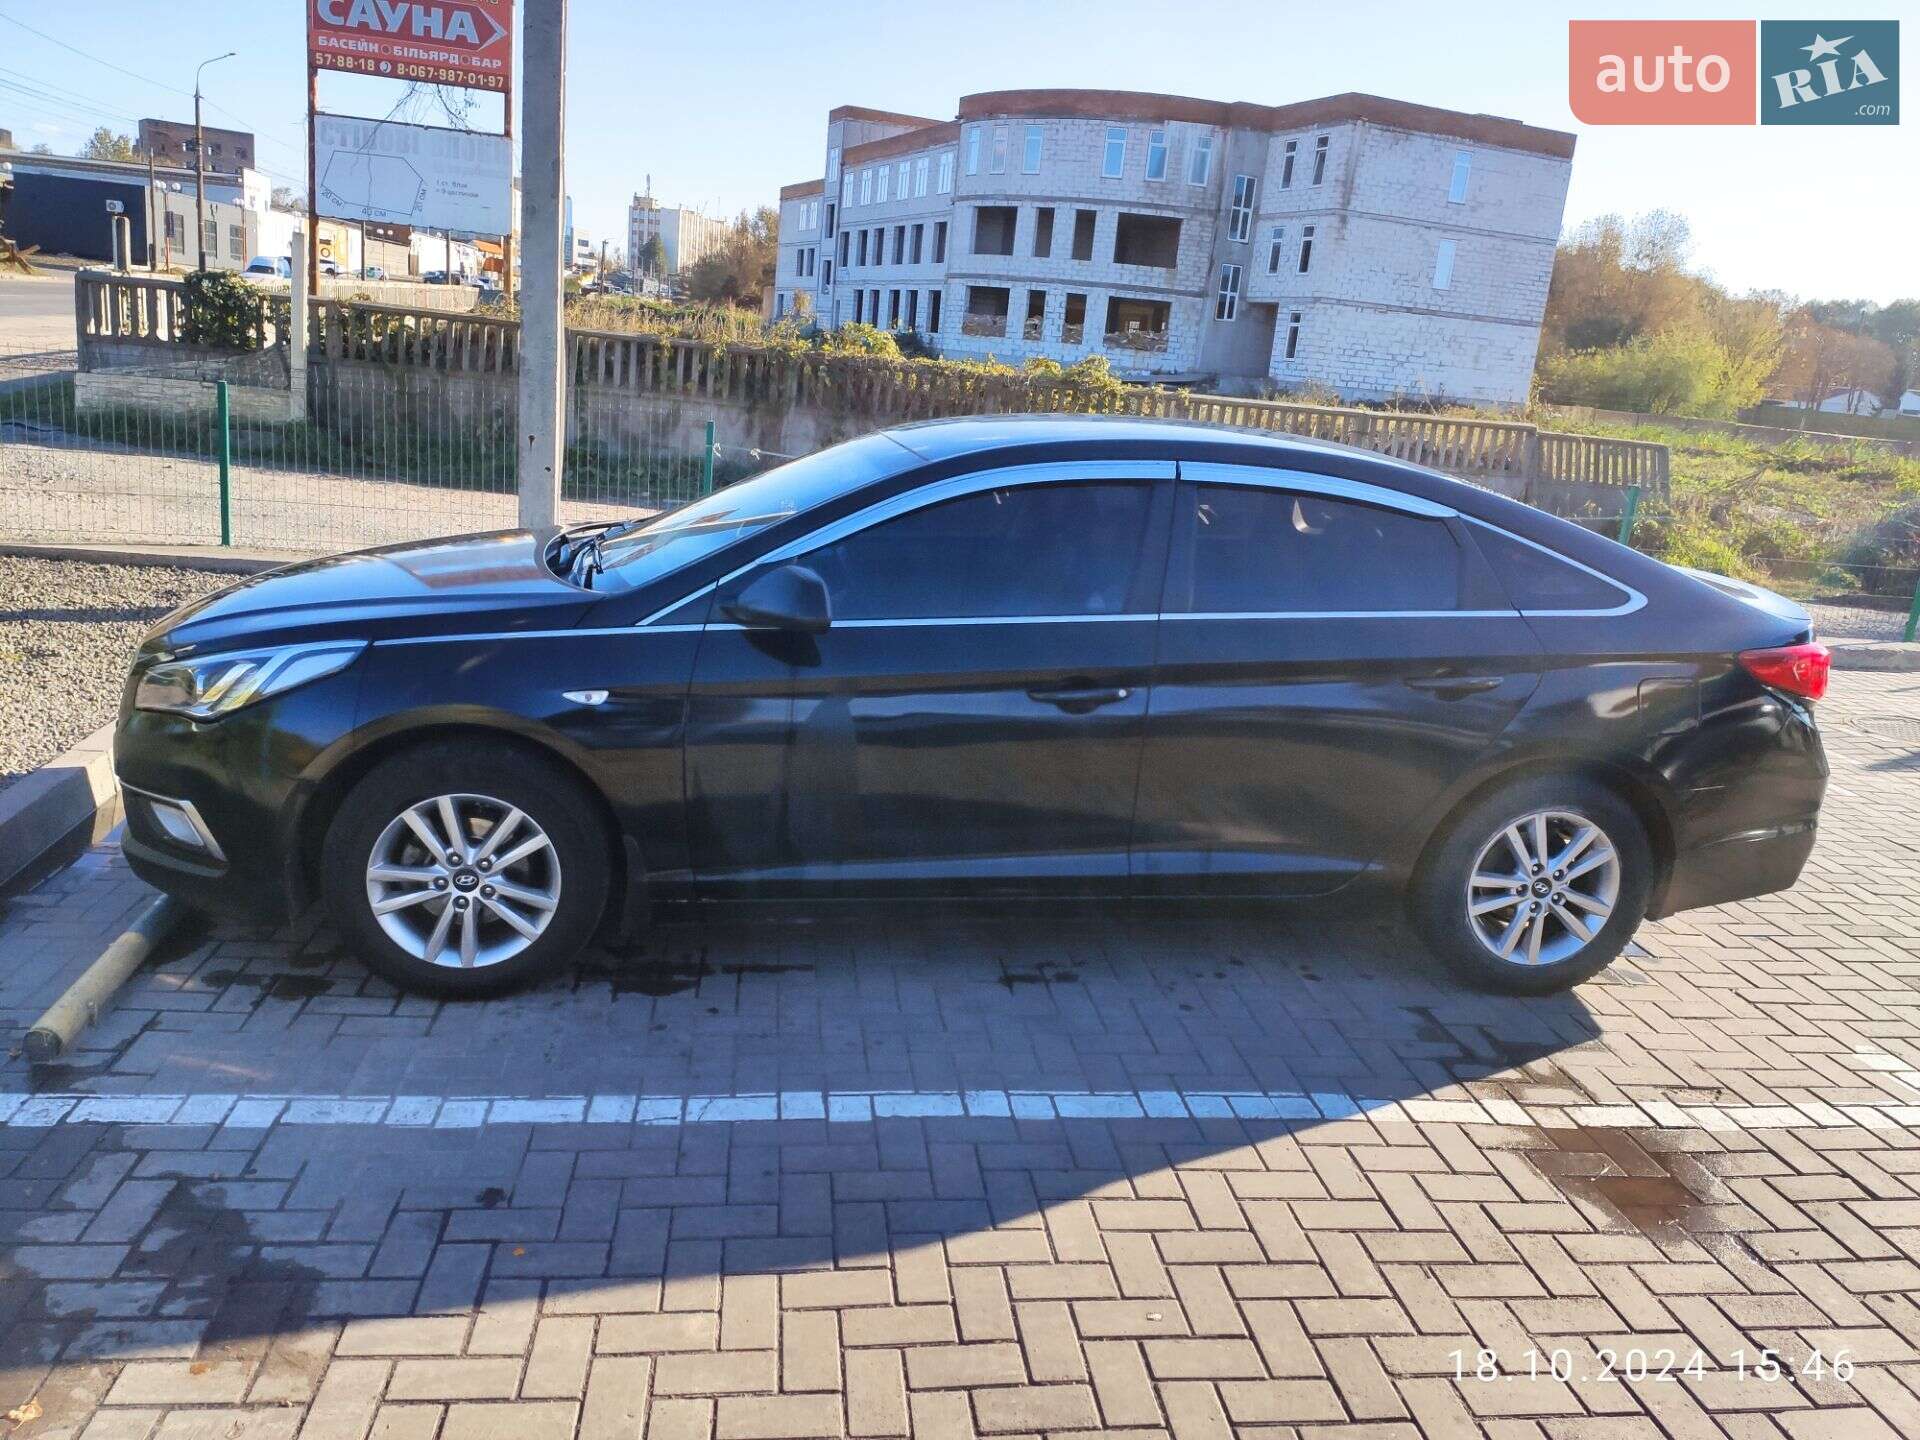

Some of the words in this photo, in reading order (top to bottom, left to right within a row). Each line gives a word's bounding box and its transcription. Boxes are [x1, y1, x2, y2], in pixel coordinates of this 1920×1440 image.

[317, 0, 480, 44] САУНА
[318, 36, 379, 53] БАСЕЙН
[393, 46, 459, 65] БІЛЬЯРД
[471, 57, 502, 68] БАР
